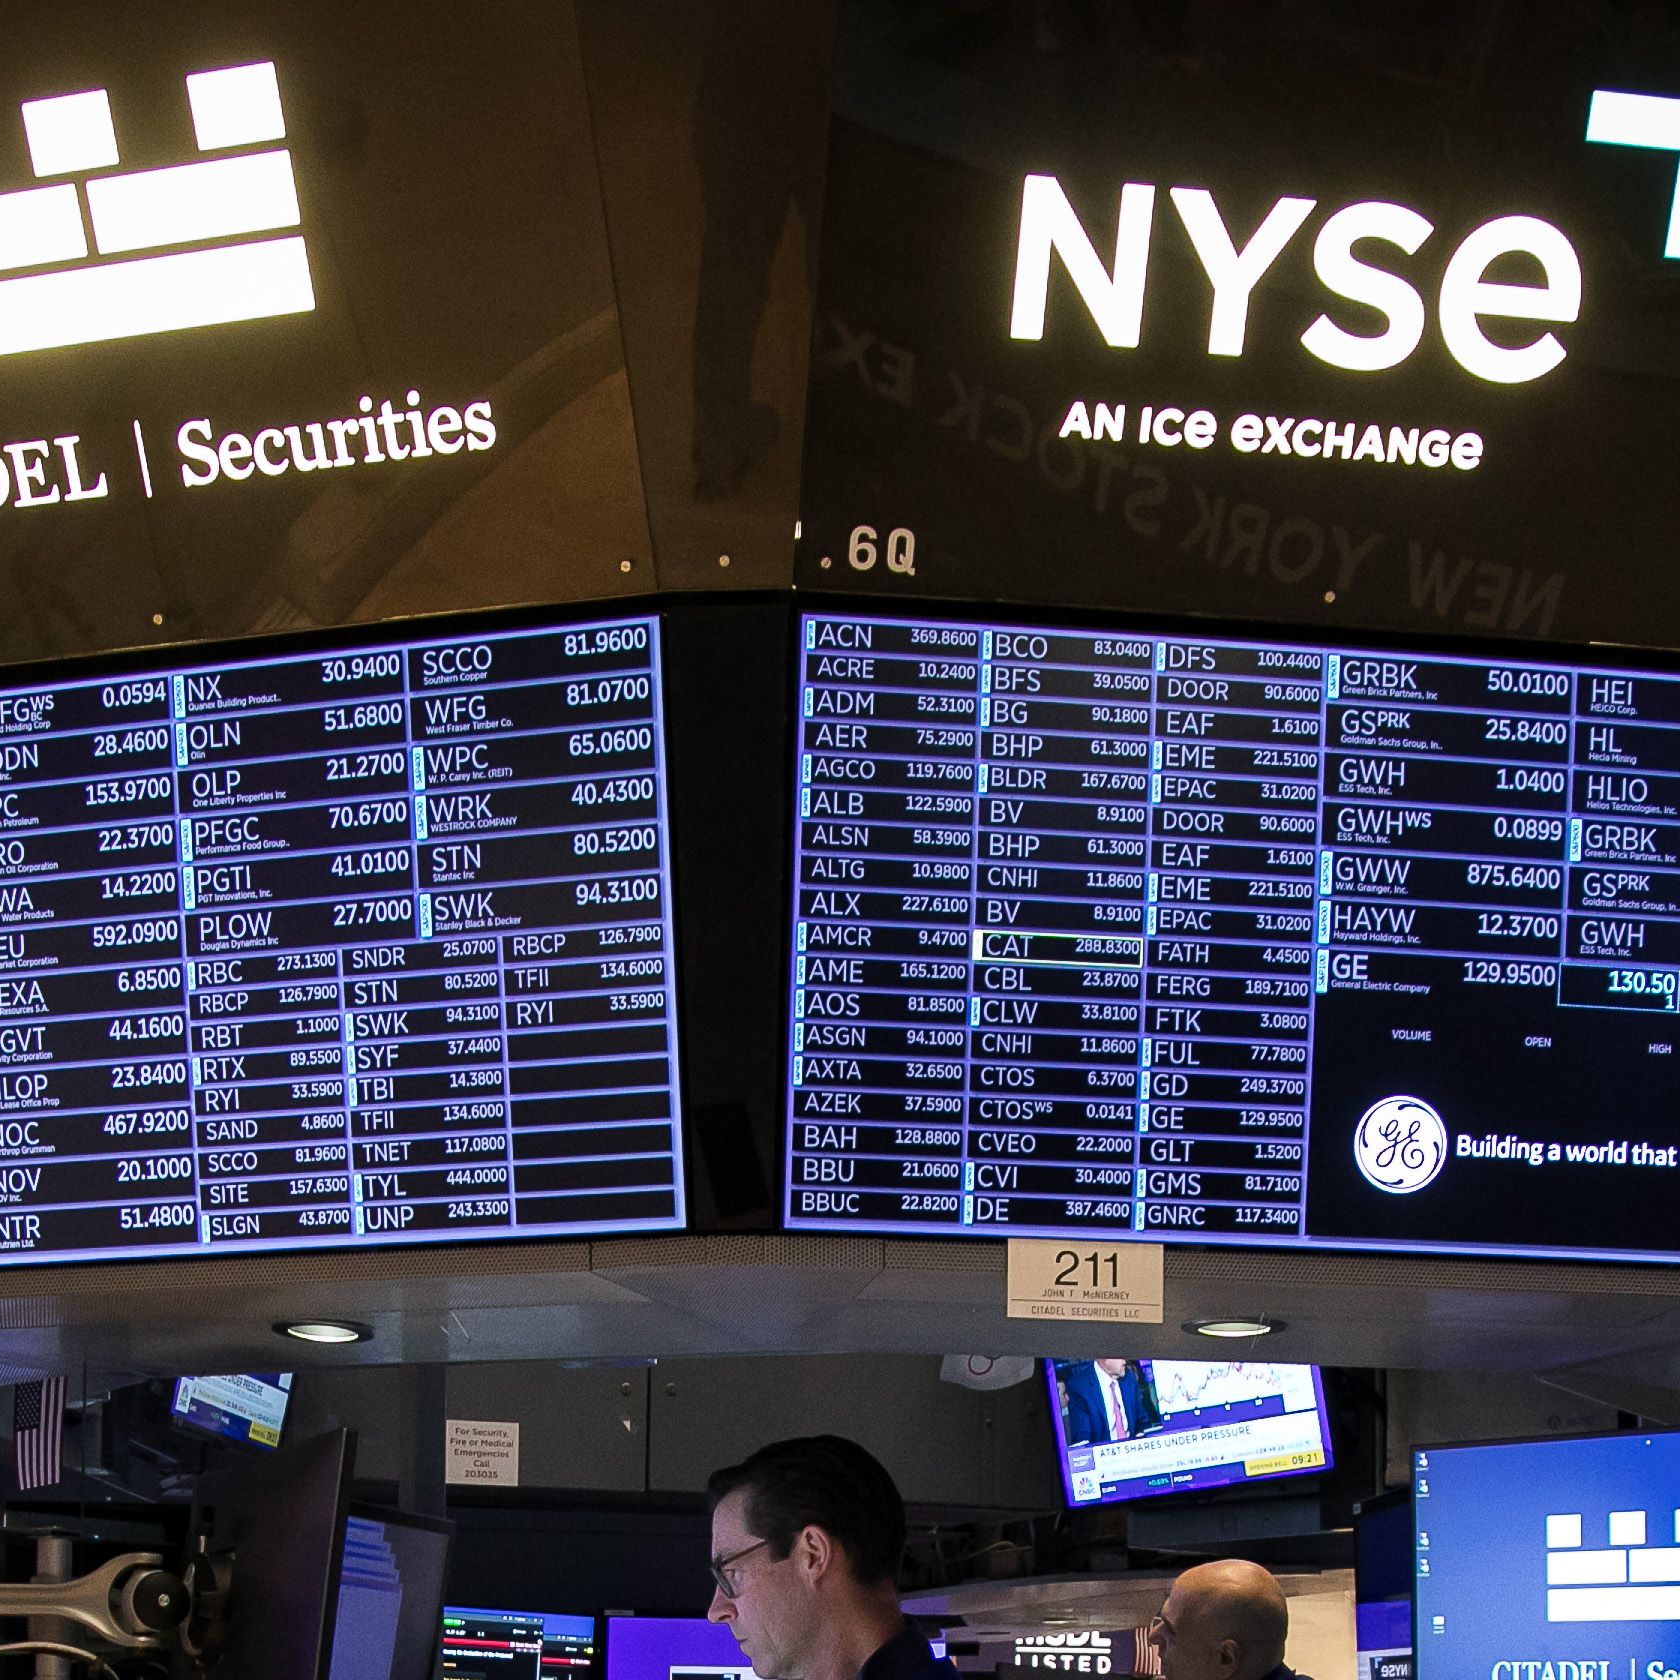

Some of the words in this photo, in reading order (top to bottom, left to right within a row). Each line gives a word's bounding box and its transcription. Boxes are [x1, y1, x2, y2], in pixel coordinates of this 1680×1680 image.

[1059, 401, 1125, 441] AN
[177, 390, 496, 487] Securities
[848, 525, 916, 576] 6Q
[818, 623, 872, 648] ACN
[911, 628, 977, 646] 369.8600
[423, 645, 492, 676] SCCO
[564, 627, 647, 656] 81.9600
[187, 674, 222, 703] NX
[321, 654, 400, 682] 30.9400
[1343, 660, 1417, 689] GRBK
[1487, 669, 1569, 696] 50.0100
[1592, 678, 1633, 706] HEI
[94, 728, 169, 757] 28.4600
[429, 793, 493, 823] WRK
[571, 777, 654, 805] 40.4300
[101, 871, 176, 899] 14.2200
[985, 934, 1033, 958] CAT
[1075, 938, 1140, 955] 288.8300
[1332, 953, 1369, 980] GE
[1463, 961, 1556, 986] 129.9500
[1609, 970, 1676, 994] 130.50
[1456, 1134, 1544, 1166] Building
[1547, 1143, 1561, 1161] a
[1565, 1140, 1628, 1164] world
[1631, 1142, 1678, 1167] that
[120, 1204, 195, 1229] 51.4800
[976, 1197, 1010, 1221] DE
[1065, 1201, 1130, 1218] 387.4600
[1055, 1250, 1118, 1288] 211
[1042, 1289, 1065, 1298] JOHN
[1031, 1306, 1066, 1316] CITADEL
[1071, 1307, 1119, 1318] SECURITIES
[1124, 1309, 1140, 1318] LLC
[450, 1438, 466, 1446] Fire
[481, 1440, 514, 1448] Medical
[455, 1427, 470, 1436] For
[472, 1428, 509, 1438] Security,
[1100, 1444, 1121, 1458] AT&T
[1124, 1439, 1162, 1455] SHARES
[1164, 1433, 1198, 1449] UNDER
[1200, 1425, 1251, 1442] PRESSURE
[454, 1449, 509, 1458] Emergencies
[473, 1460, 490, 1468] Call
[1291, 1452, 1319, 1466] 09:21
